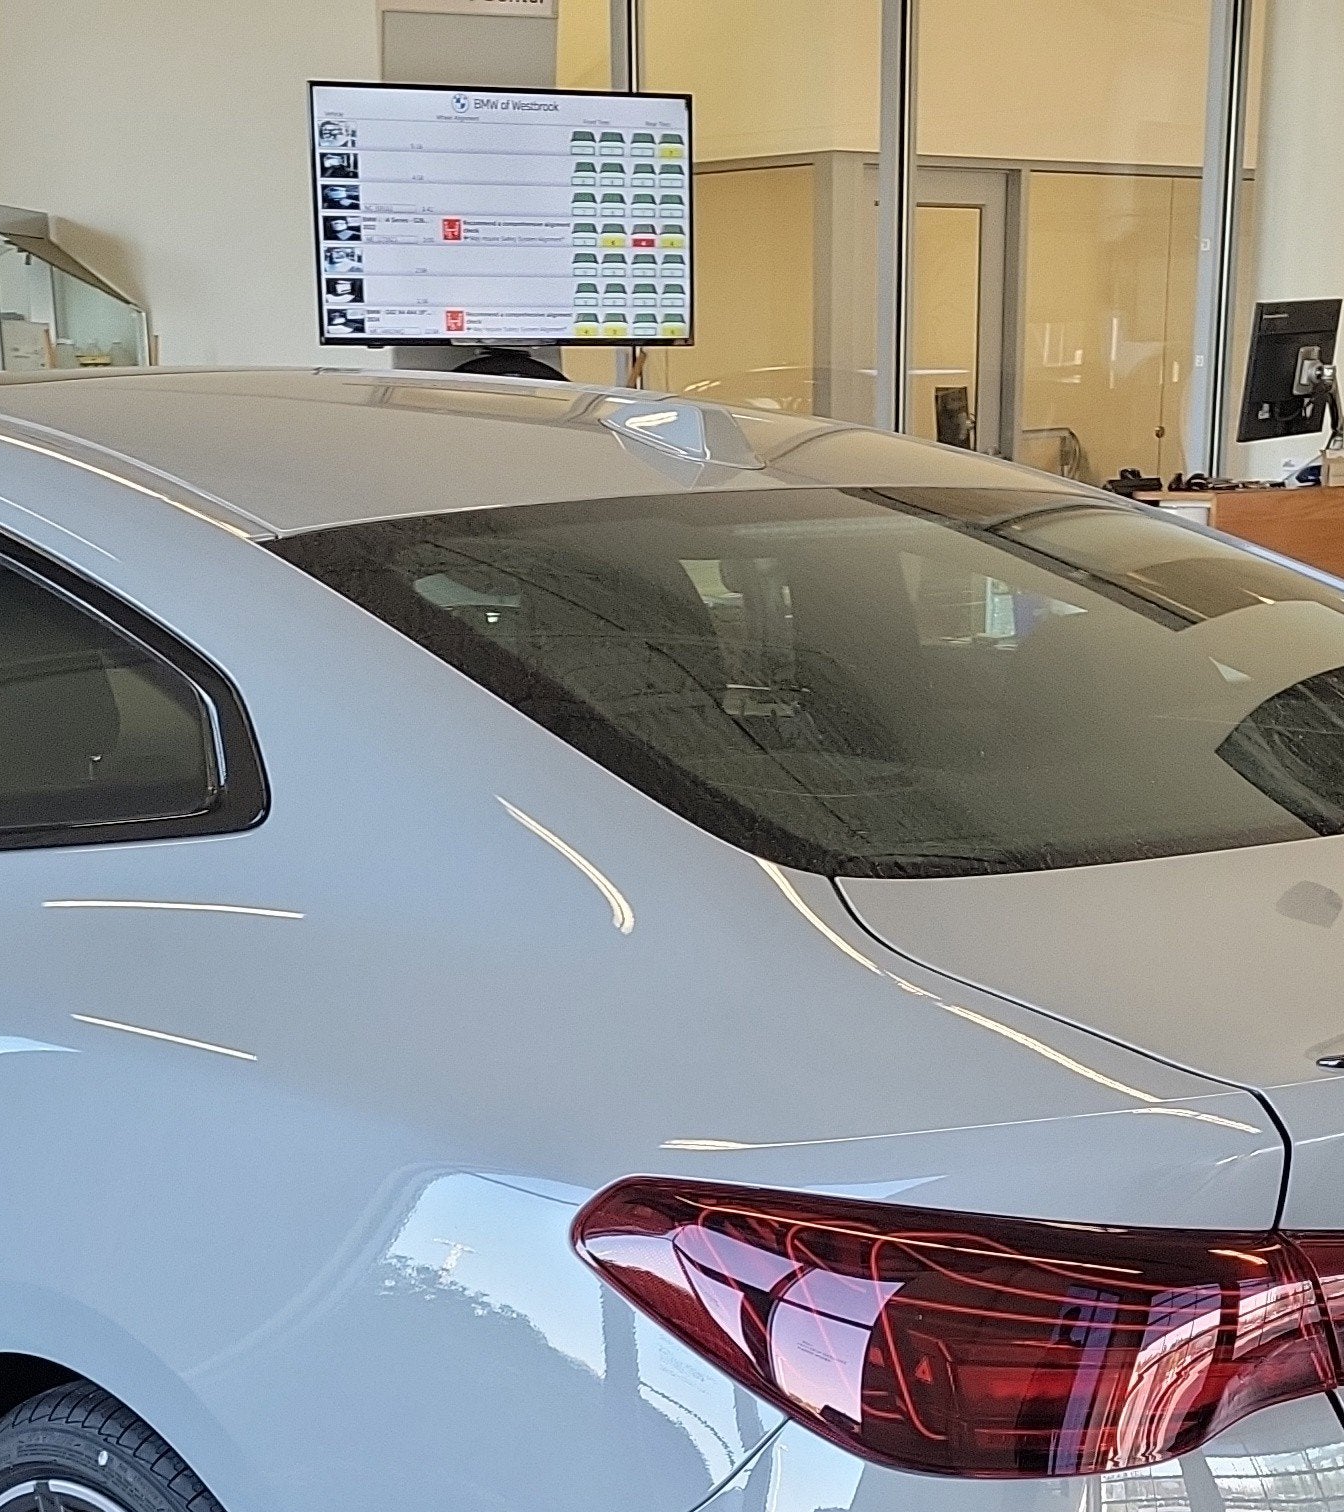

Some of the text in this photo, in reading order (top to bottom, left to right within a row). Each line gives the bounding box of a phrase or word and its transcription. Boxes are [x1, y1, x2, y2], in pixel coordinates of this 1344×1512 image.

[474, 99, 560, 113] BMW of Westbrook
